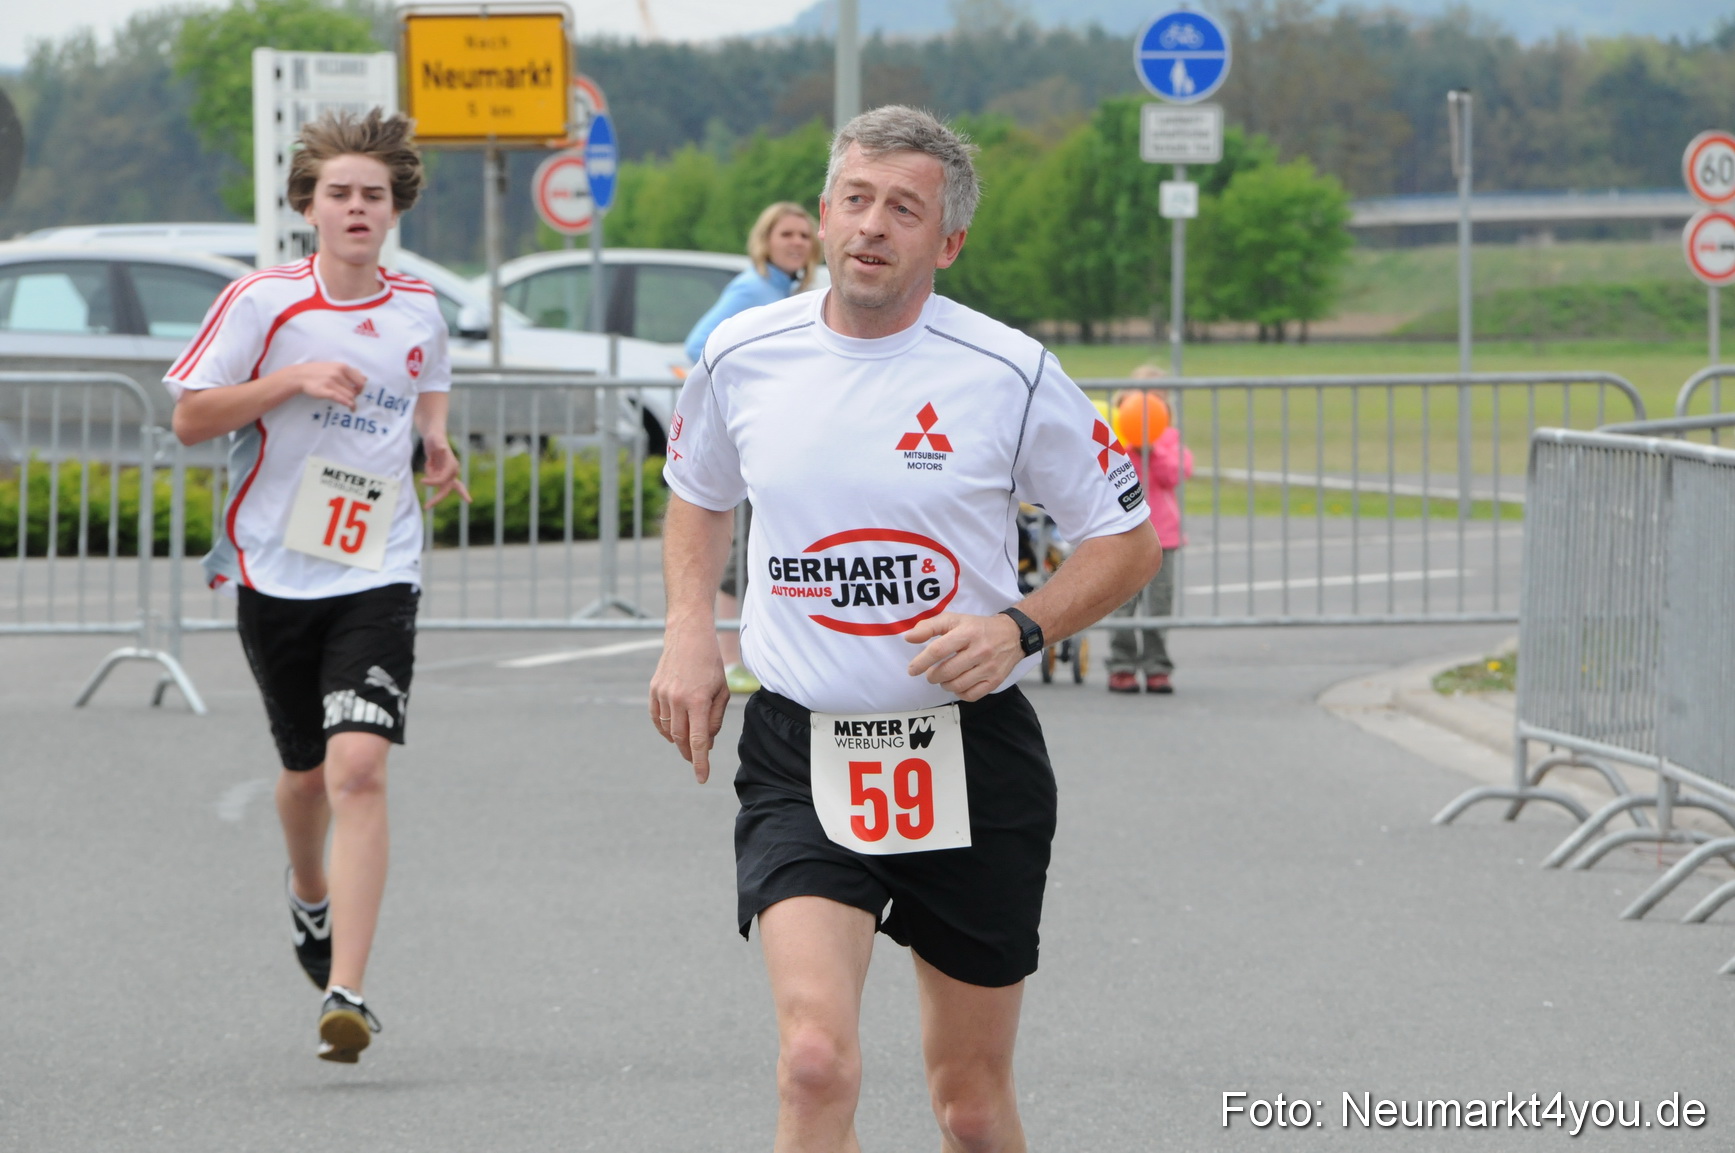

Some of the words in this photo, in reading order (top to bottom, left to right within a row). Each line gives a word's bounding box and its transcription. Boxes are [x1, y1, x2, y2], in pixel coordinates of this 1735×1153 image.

[464, 35, 510, 48] Nach
[422, 59, 553, 90] Neumarkt
[489, 102, 514, 117] km
[1701, 153, 1735, 187] 60
[322, 406, 377, 434] jeans
[904, 451, 947, 461] MITSUBISHI
[907, 462, 943, 471] MOTORS
[322, 467, 367, 487] MEYER
[323, 496, 371, 554] 15
[768, 554, 918, 582] GERHART
[921, 558, 936, 573] &
[771, 585, 833, 598] AUTOHAUS
[831, 578, 941, 608] JÄNIG
[834, 719, 903, 737] MEYER
[834, 736, 905, 750] WERBUNG
[848, 757, 935, 843] 59
